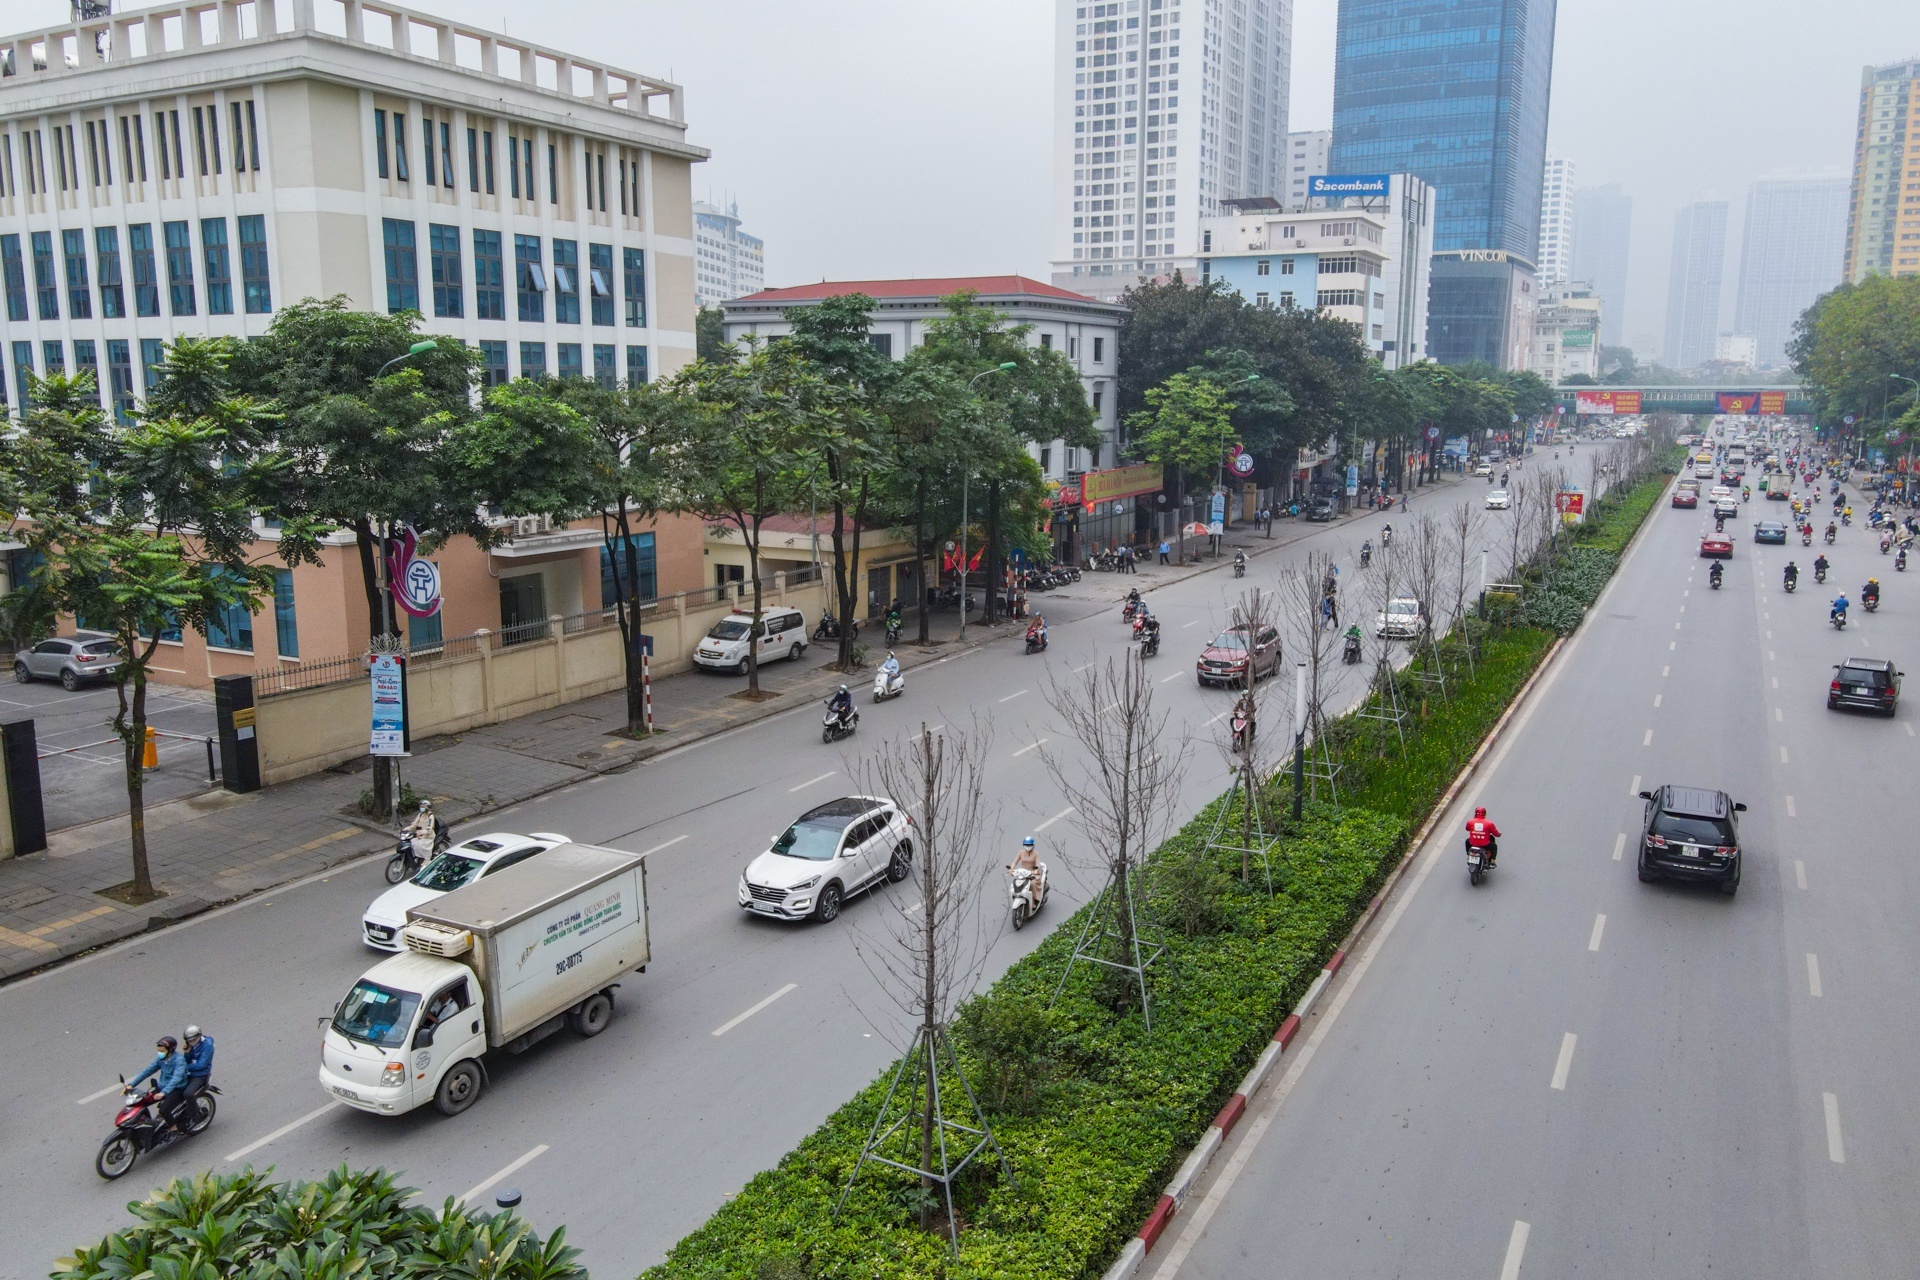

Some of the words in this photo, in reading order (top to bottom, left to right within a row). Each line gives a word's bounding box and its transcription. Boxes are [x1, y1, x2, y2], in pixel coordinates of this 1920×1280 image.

[1314, 179, 1384, 191] Sacombank
[1460, 250, 1507, 262] VINCOM
[547, 923, 558, 935] CÔNG
[559, 920, 564, 928] TY
[584, 900, 604, 917] QUANG
[605, 892, 621, 905] MINH
